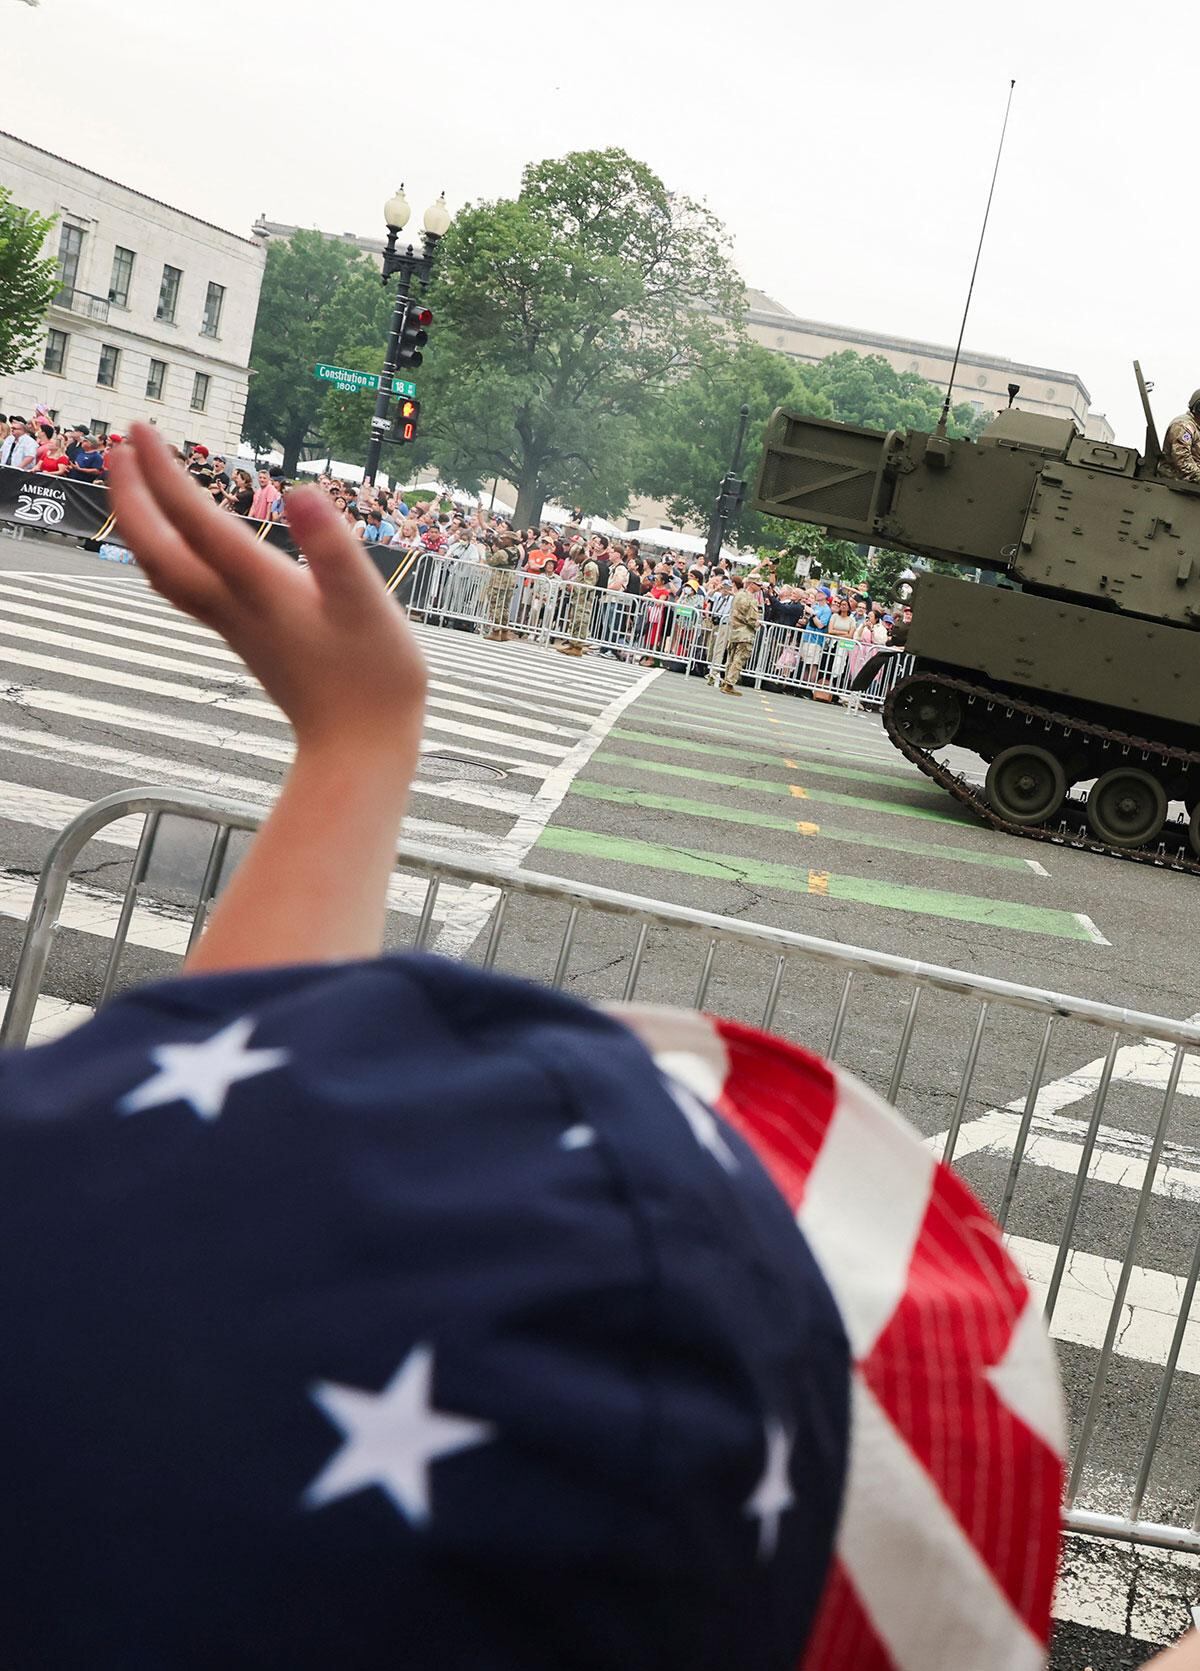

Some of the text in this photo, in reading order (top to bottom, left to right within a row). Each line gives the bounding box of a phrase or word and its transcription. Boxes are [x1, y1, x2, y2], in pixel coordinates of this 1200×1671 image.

[319, 366, 367, 385] Constitution
[336, 381, 356, 392] 1800
[395, 381, 405, 393] 18
[403, 423, 413, 439] 0
[20, 483, 67, 500] AMERICA
[14, 495, 64, 525] 250
